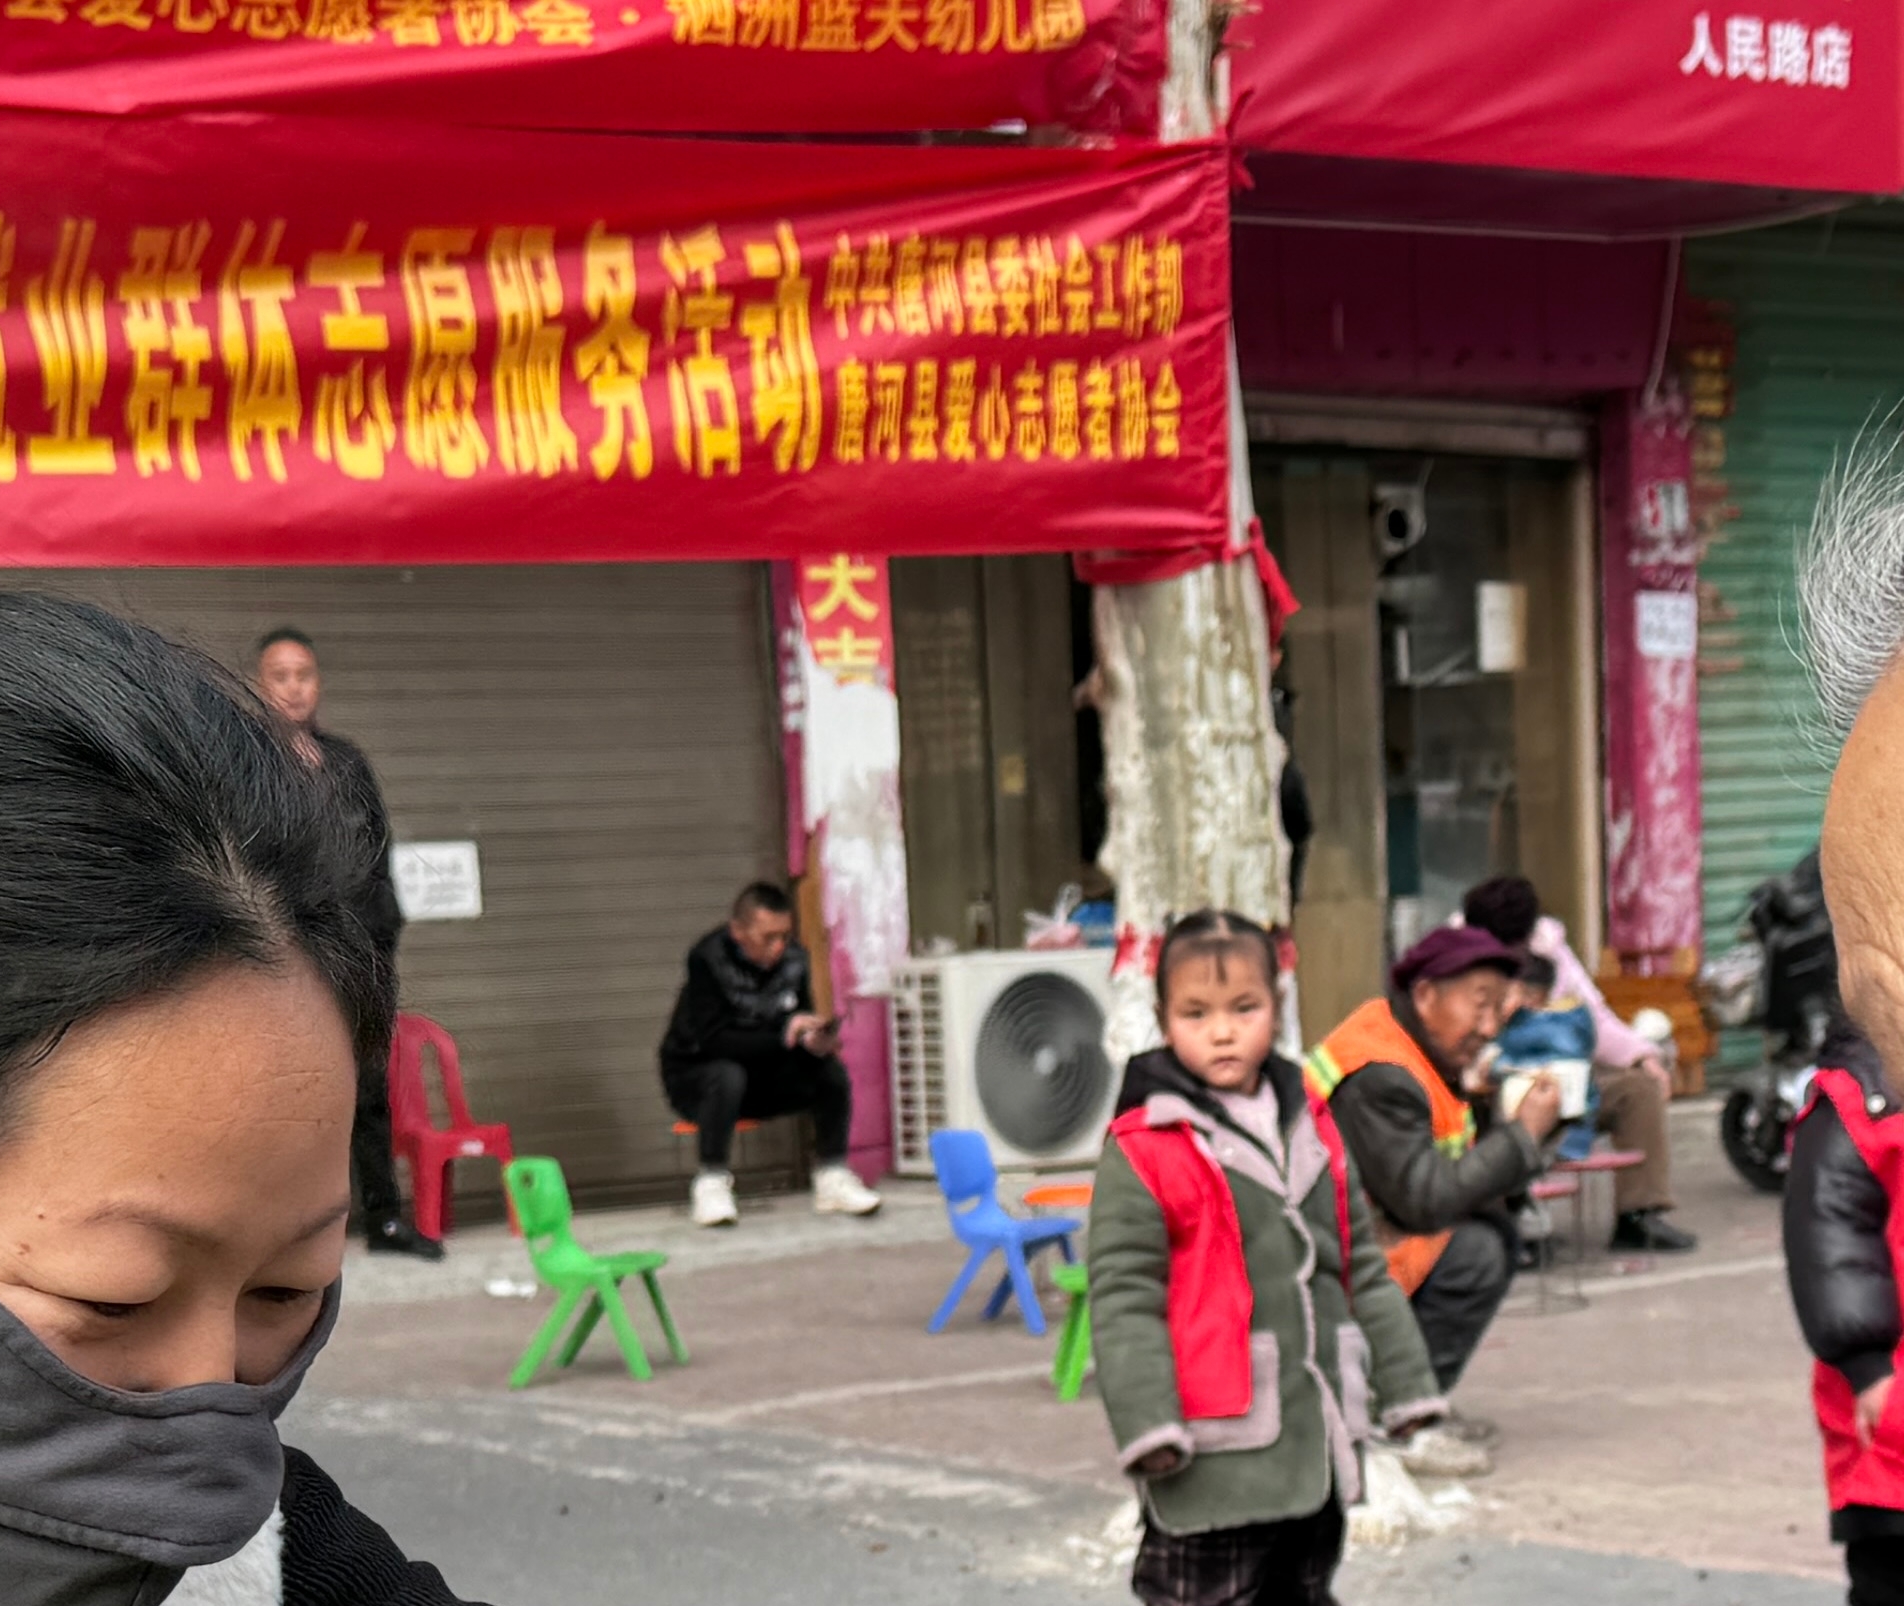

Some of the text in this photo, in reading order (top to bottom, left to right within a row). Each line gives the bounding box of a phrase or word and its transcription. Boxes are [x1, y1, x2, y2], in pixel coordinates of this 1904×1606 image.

[1679, 10, 1853, 90] 人民路店
[834, 354, 1183, 463] 唐河县爱心志愿者协会
